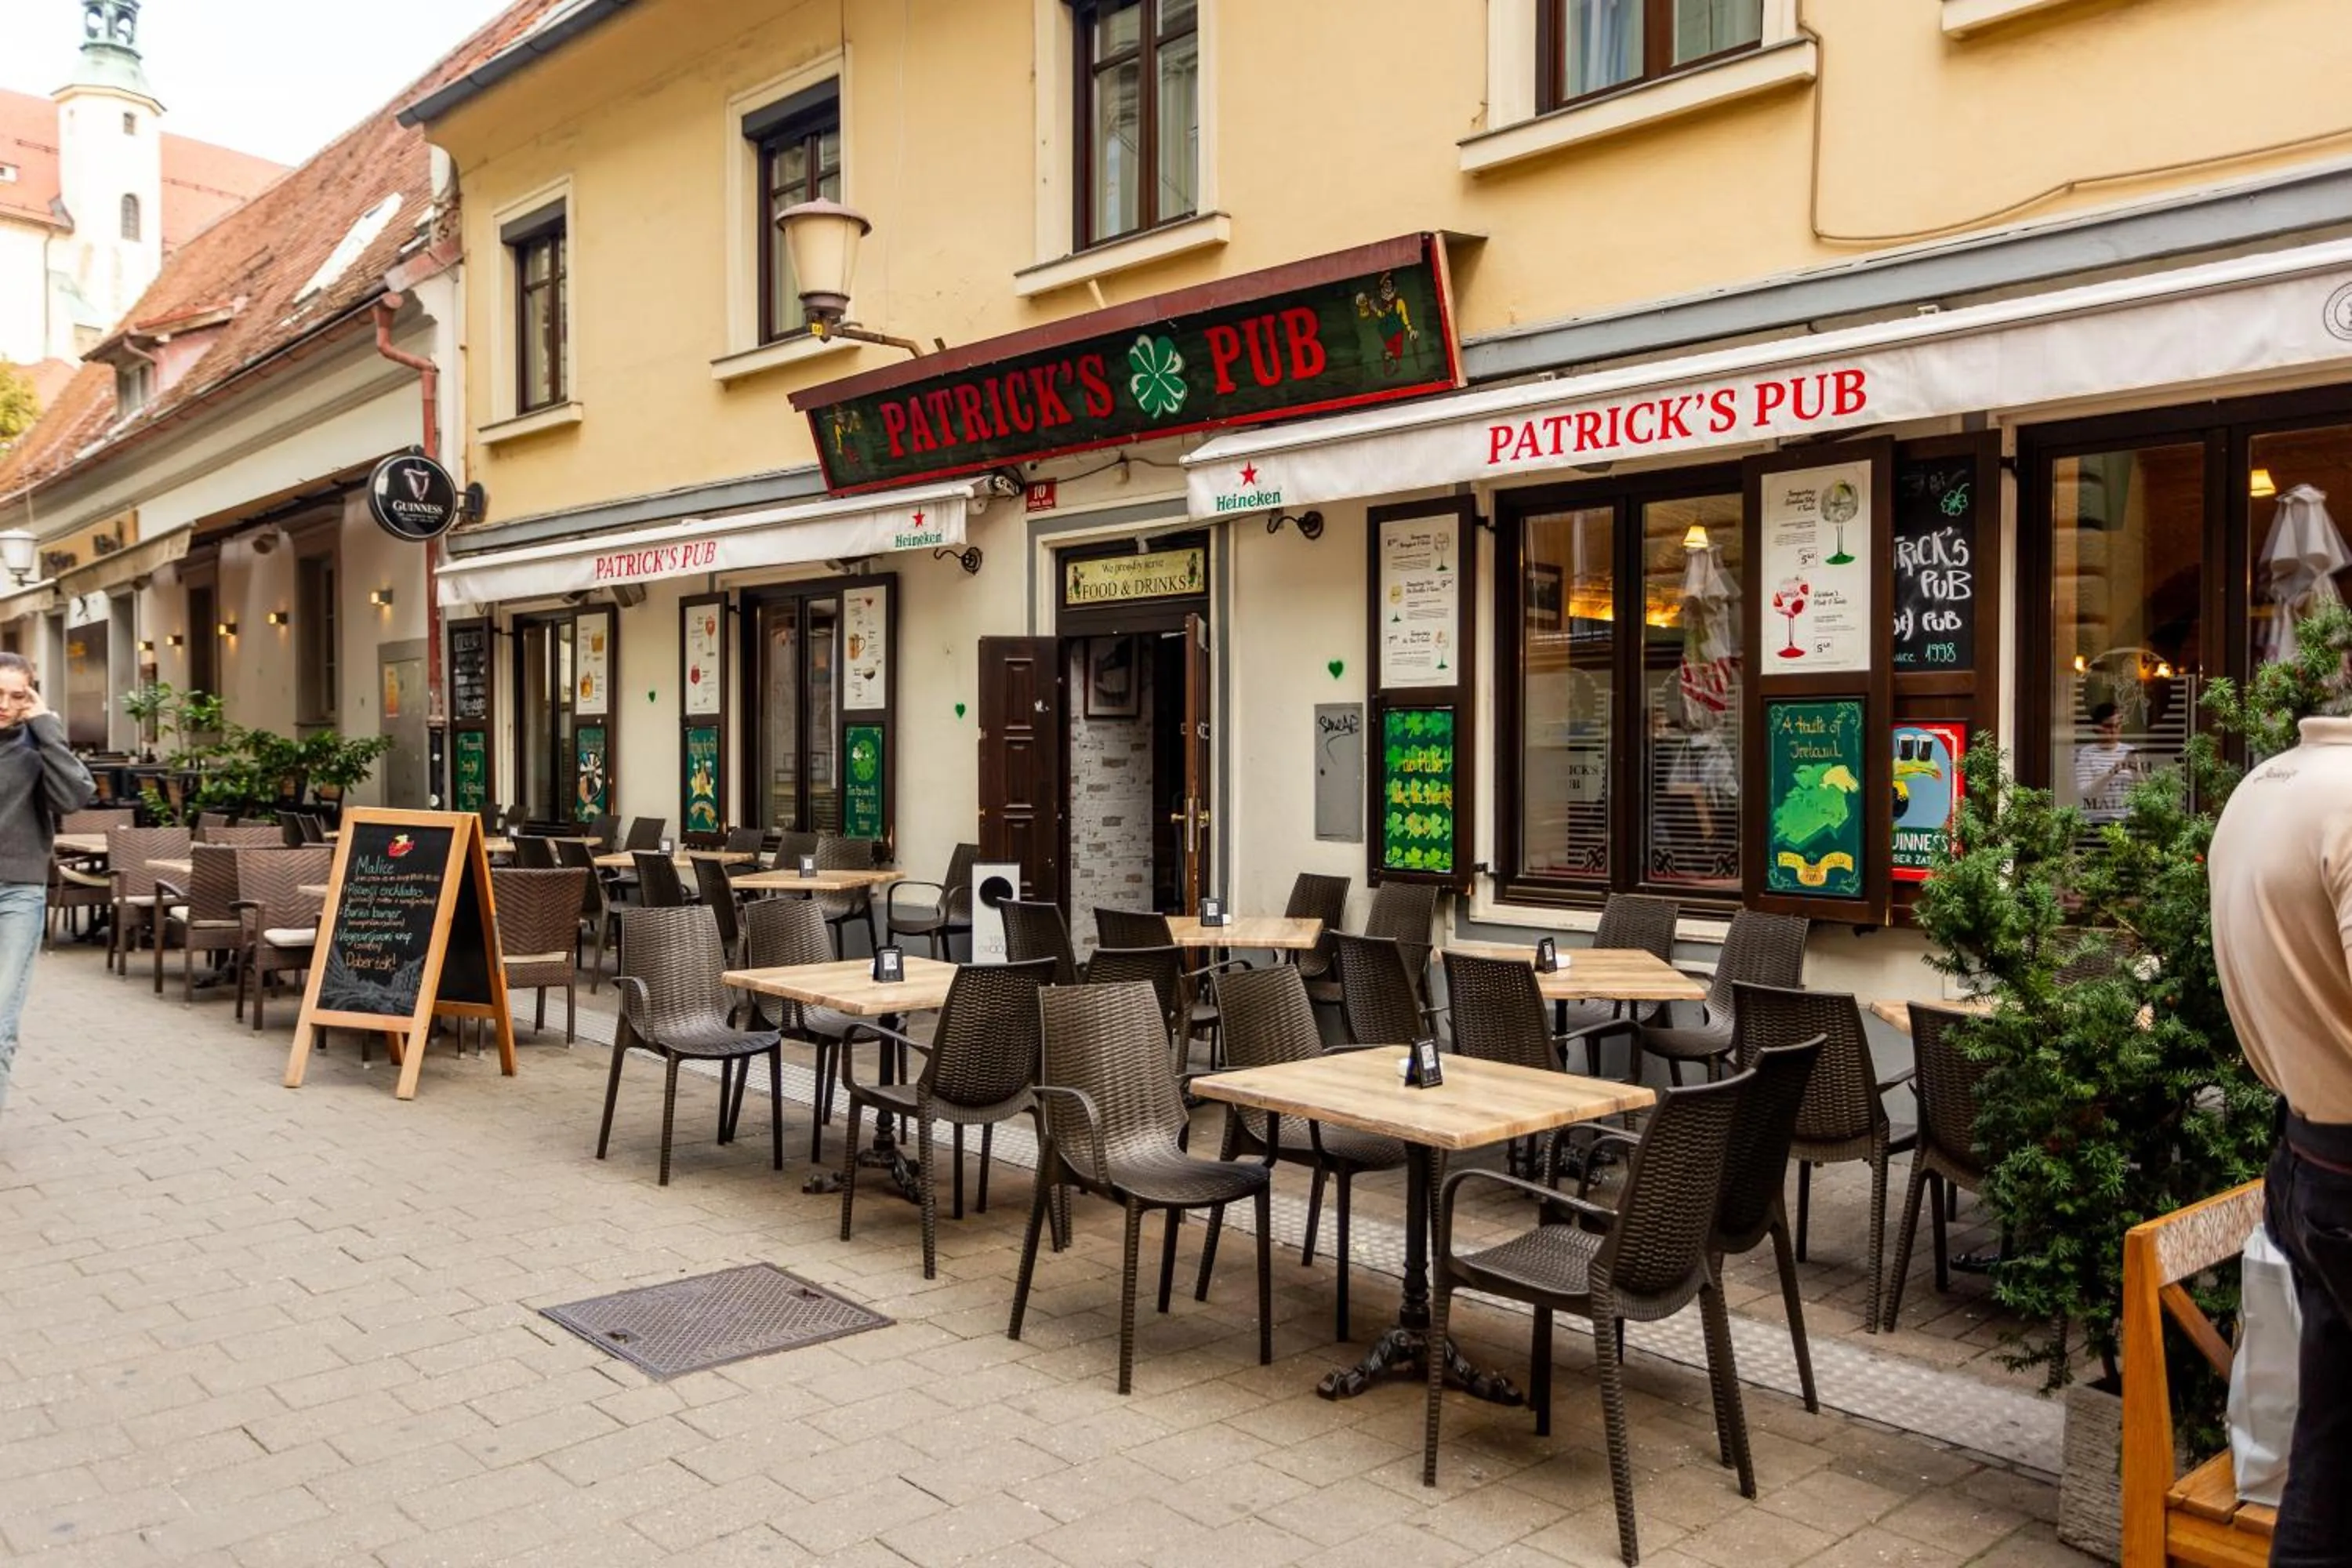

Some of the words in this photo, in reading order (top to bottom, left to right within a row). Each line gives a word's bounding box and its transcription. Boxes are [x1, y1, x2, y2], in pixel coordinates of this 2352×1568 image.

[879, 353, 1116, 459] PATRICK'S
[1204, 307, 1327, 394] PUB
[1487, 387, 1737, 466] PATRICK'S
[1754, 366, 1868, 428] PUB
[392, 499, 444, 515] GUINNESS
[1215, 488, 1282, 513] Heineken
[895, 532, 943, 548] Heineken
[595, 546, 677, 579] PATRICK'S
[680, 541, 717, 569] PUB
[1083, 582, 1117, 600] FOOD
[1120, 580, 1131, 597] &
[1134, 575, 1186, 595] DRINKS
[1925, 642, 1957, 662] 1998
[1779, 714, 1794, 735] A
